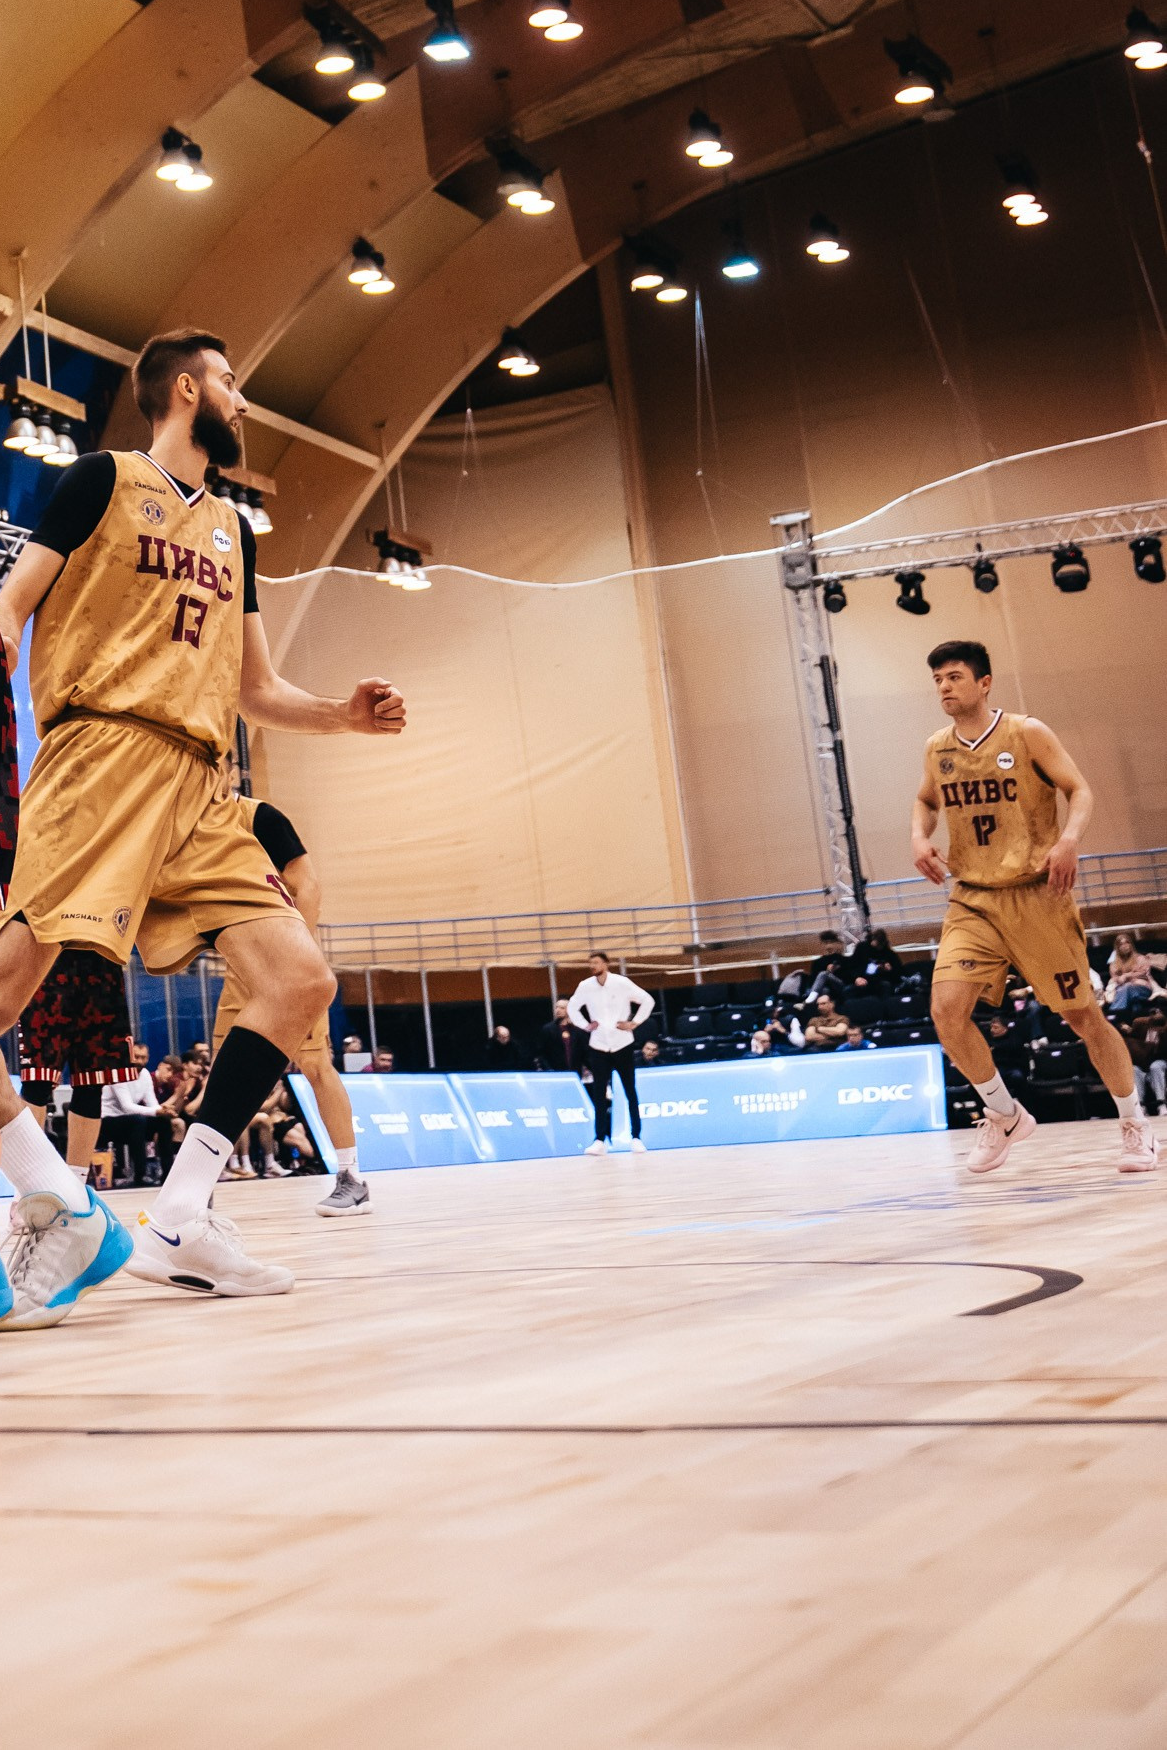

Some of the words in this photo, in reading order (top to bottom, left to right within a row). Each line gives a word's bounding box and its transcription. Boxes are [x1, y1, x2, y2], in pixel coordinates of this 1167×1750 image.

[136, 534, 233, 602] ЦИВС
[171, 593, 209, 650] 13
[940, 777, 1018, 809] ЦИВС
[660, 1098, 709, 1118] DKC
[862, 1083, 914, 1104] DKC
